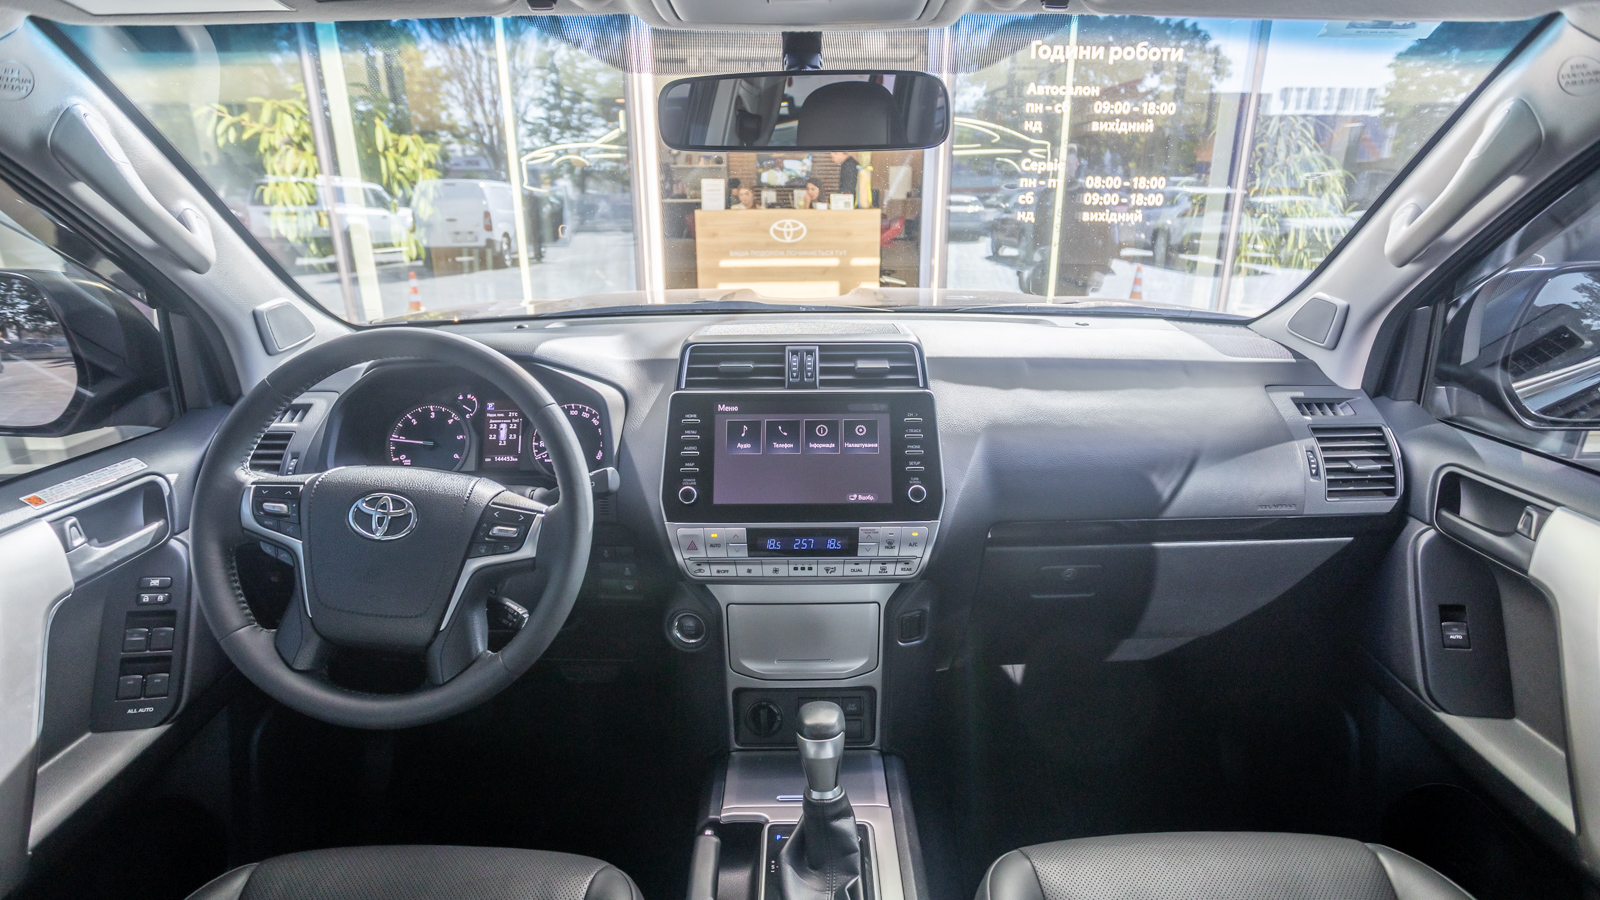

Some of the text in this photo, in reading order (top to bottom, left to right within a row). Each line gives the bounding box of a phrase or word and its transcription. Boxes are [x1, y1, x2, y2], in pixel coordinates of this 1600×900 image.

[1030, 40, 1184, 64] Години роботи
[1027, 82, 1100, 96] Автосалон
[1025, 103, 1043, 113] пн
[1093, 101, 1131, 114] 09:00
[1142, 101, 1176, 115] 18:00
[1024, 119, 1154, 134] нд вихідний
[1019, 177, 1037, 188] пн
[1085, 176, 1122, 189] 08:00
[1132, 176, 1166, 190] 18:00
[1018, 192, 1034, 205] сб
[1083, 192, 1119, 206] 09:00
[1130, 193, 1163, 207] 18:00
[1017, 209, 1143, 223] нд вихідний
[717, 404, 739, 412] Меню
[766, 538, 781, 550] 18.5
[826, 538, 842, 550] 18.5
